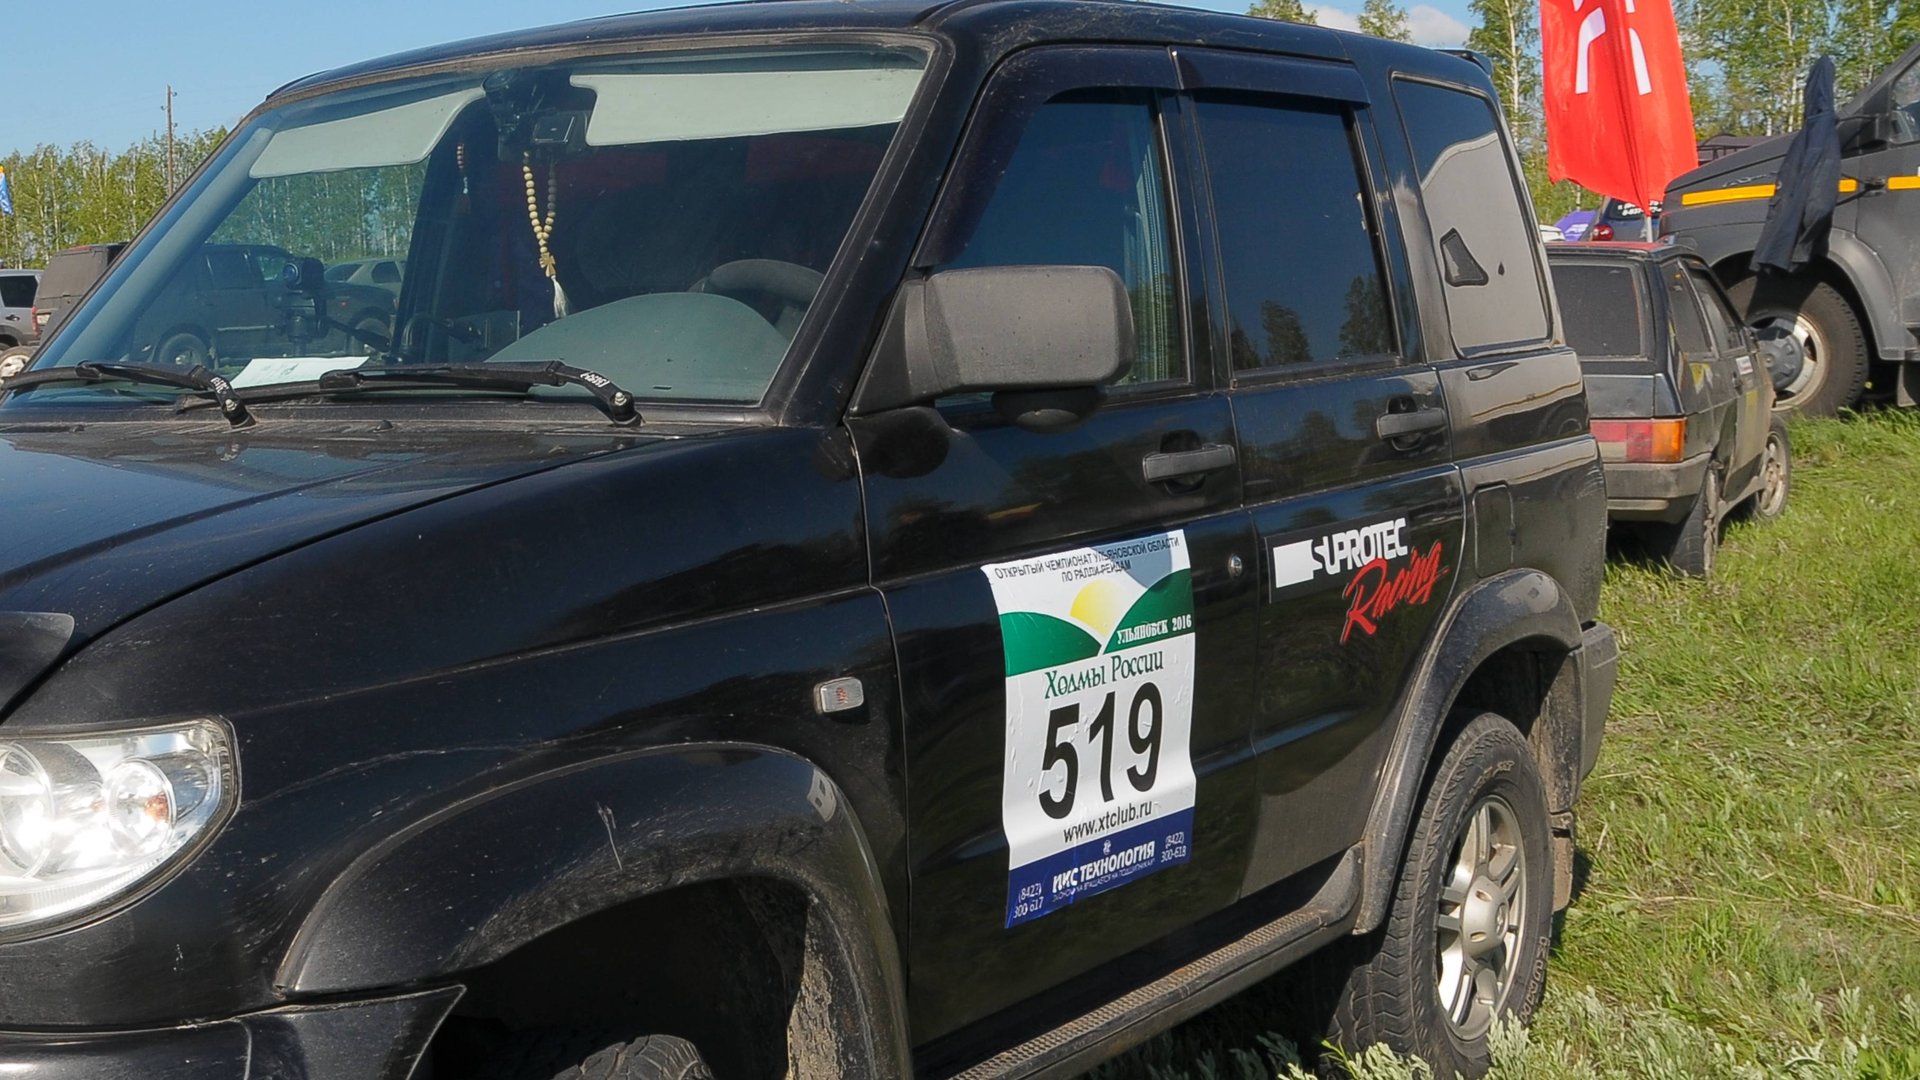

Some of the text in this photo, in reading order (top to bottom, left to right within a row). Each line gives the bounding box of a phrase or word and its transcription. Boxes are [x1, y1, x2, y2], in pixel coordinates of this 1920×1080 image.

[994, 536, 1180, 580] ОТКРЫТЫЙ ЧЕМПИОНАТ УЛЬЯНОВСКОЙ ОБЛАСТИ
[1311, 517, 1408, 576] SUPROTEC
[1061, 570, 1073, 583] ПО
[1340, 540, 1450, 645] Racing
[1172, 614, 1192, 632] 2016
[1045, 651, 1163, 699] Холмы России
[1038, 681, 1163, 819] 519
[1062, 800, 1153, 844] www.xtclub.ru
[1080, 840, 1155, 882] ТЕХНОЛОГИЯ
